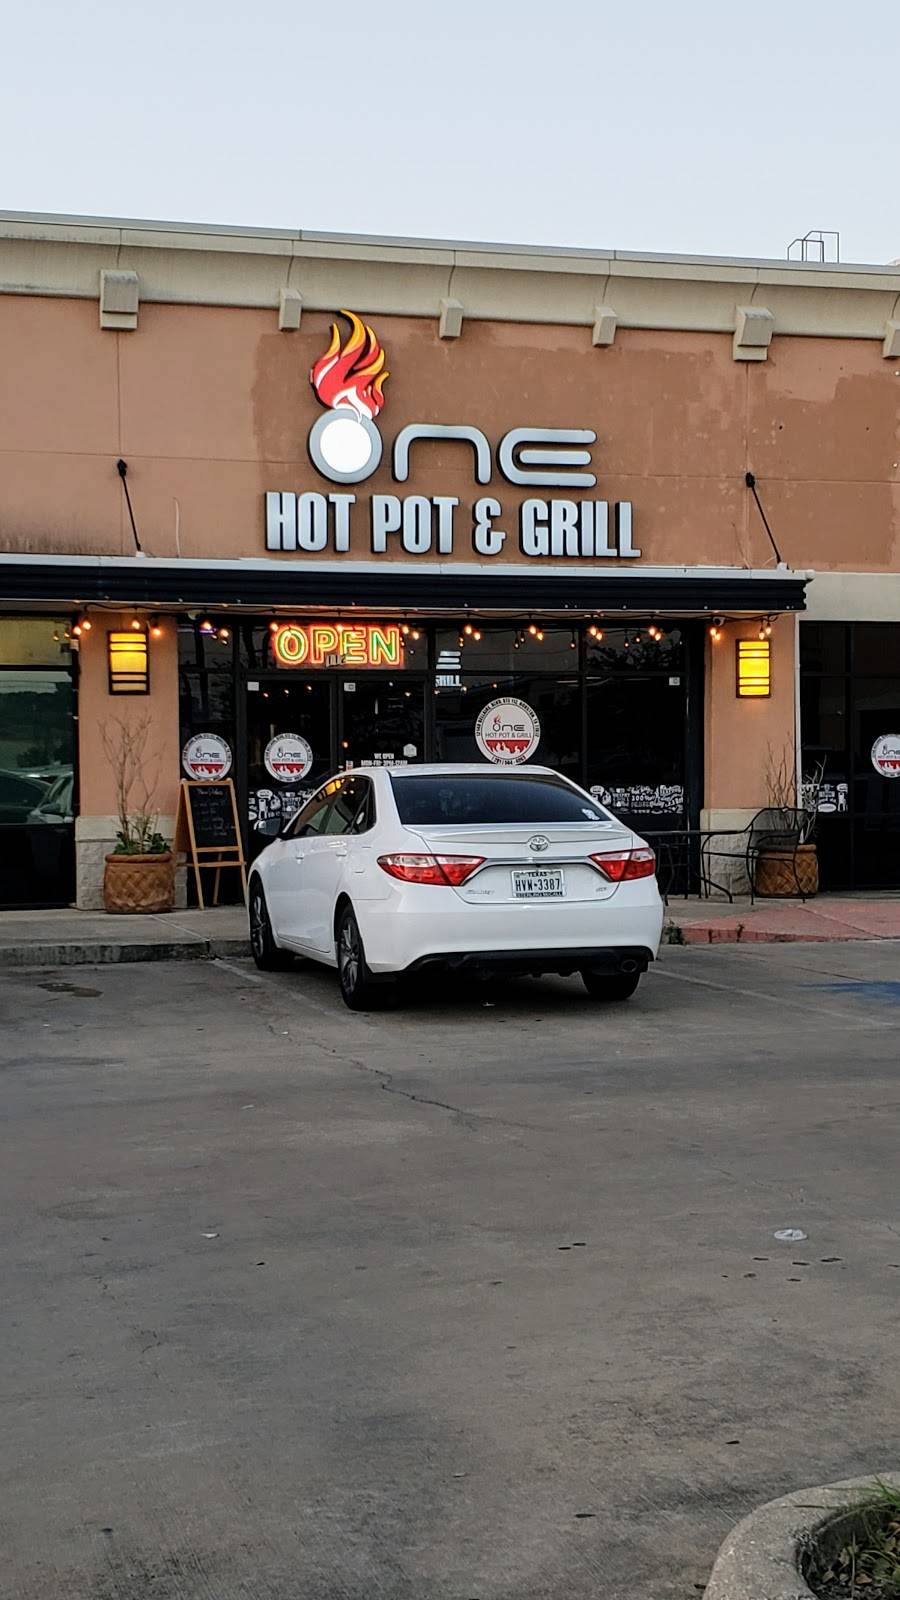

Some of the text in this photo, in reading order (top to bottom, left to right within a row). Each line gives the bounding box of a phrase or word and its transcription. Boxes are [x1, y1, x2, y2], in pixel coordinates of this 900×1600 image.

[308, 408, 598, 488] ONE
[265, 491, 642, 559] HOT POT & GRILL
[274, 625, 402, 666] OPEN
